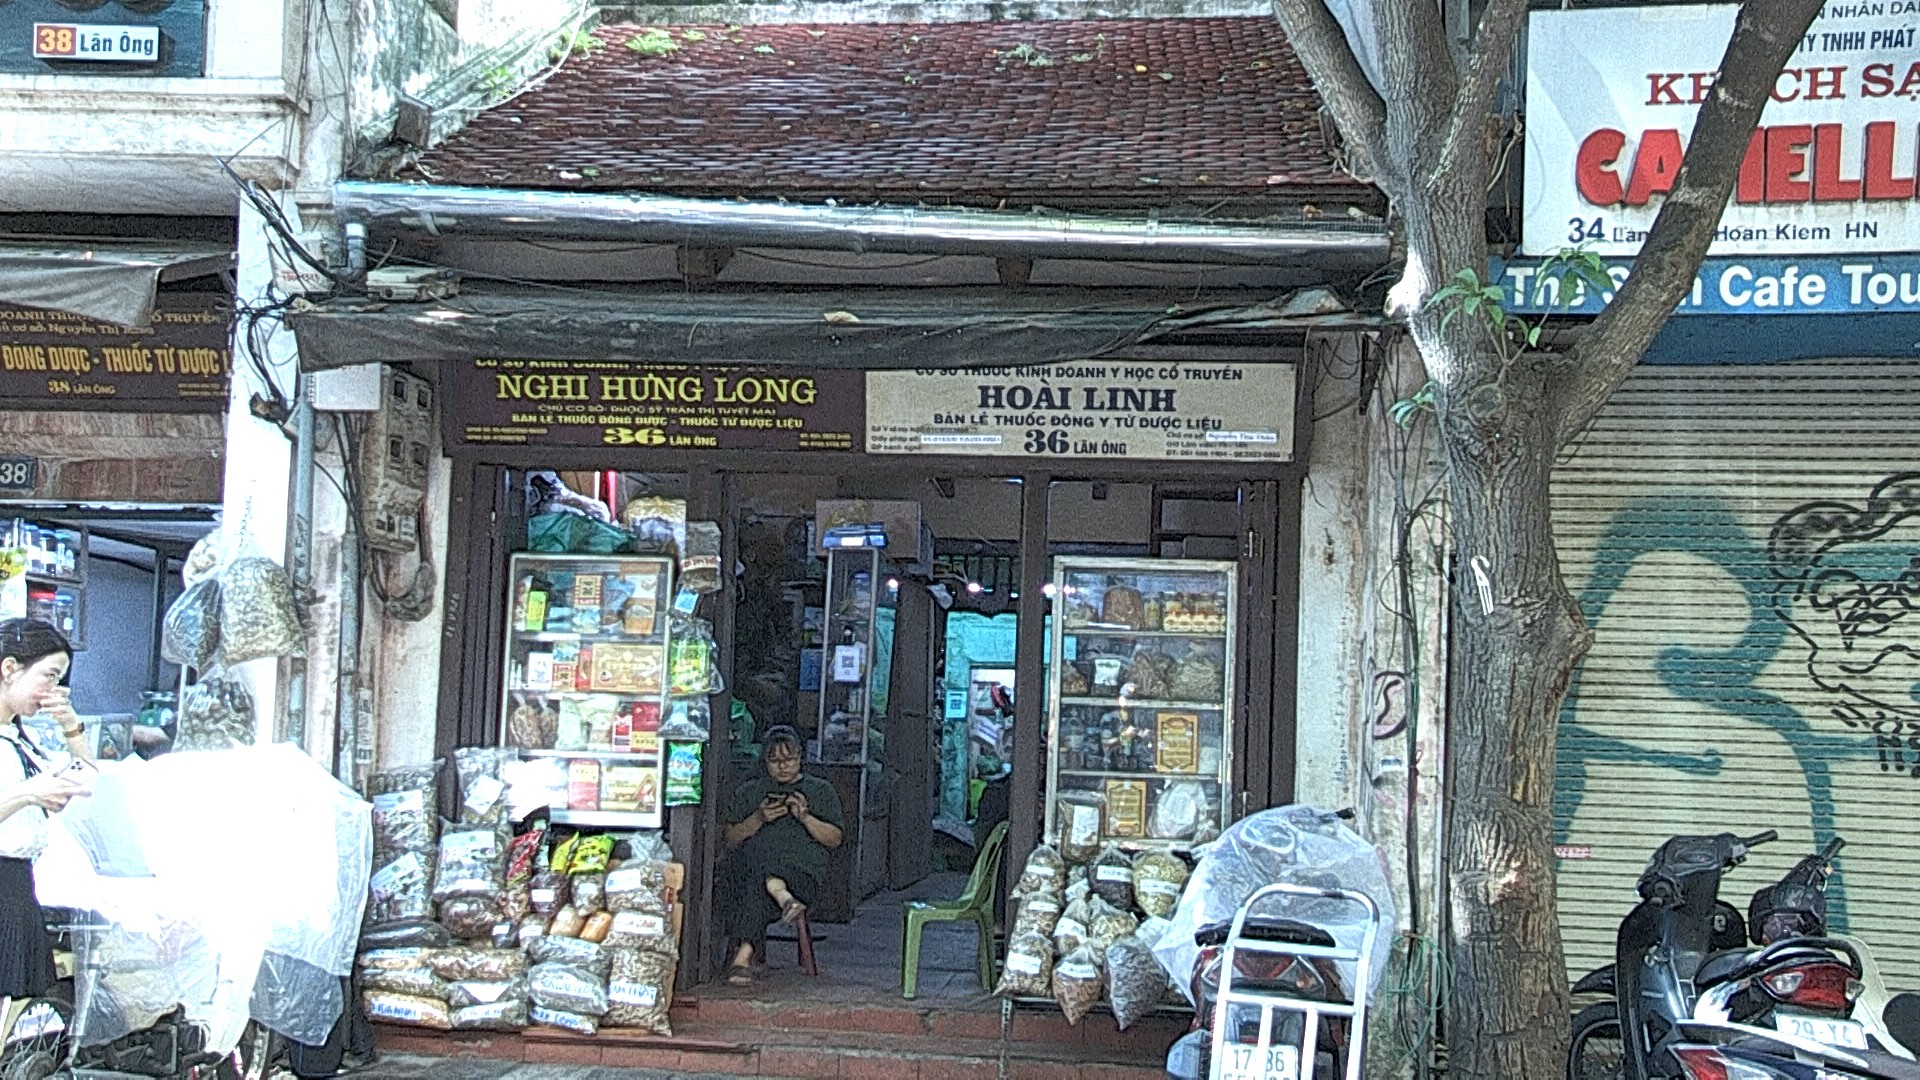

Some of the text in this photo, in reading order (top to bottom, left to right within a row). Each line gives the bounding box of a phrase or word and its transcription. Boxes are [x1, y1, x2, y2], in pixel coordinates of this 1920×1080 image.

[1832, 1, 1884, 18] NHÂN
[39, 28, 73, 53] 38
[119, 31, 154, 56] Ông
[1822, 32, 1866, 52] TNHH
[1870, 23, 1917, 50] PHÁT
[1646, 65, 1847, 106] KHCH
[1568, 217, 1605, 243] 34
[1846, 221, 1878, 239] HN
[1720, 264, 1826, 306] Cafe
[2, 341, 47, 370] ĐÔNG
[49, 347, 91, 376] DƯỢC
[102, 342, 153, 373] THUỐC
[179, 347, 220, 378] DƯỢC
[1016, 366, 1051, 379] KINH
[1055, 367, 1106, 379] DOANH
[1110, 367, 1121, 379] Y
[1124, 367, 1155, 382] HỌC
[496, 373, 818, 404] NGHI HƯNG LONG
[977, 378, 1177, 412] HOÀI LINH
[557, 413, 596, 425] THUỐC
[679, 416, 719, 427] THUỐC
[776, 418, 803, 430] LIỆU
[994, 411, 1046, 427] THUỐC
[1050, 412, 1094, 428] ĐÔNG
[1099, 416, 1109, 428] Y
[1139, 416, 1181, 431] DƯỢC
[1187, 415, 1223, 431] LIỆU
[603, 427, 667, 445] 36
[693, 434, 717, 447] ÔNG
[1024, 429, 1071, 454] 36
[1102, 438, 1127, 456] ÔNG
[0, 462, 28, 484] 38
